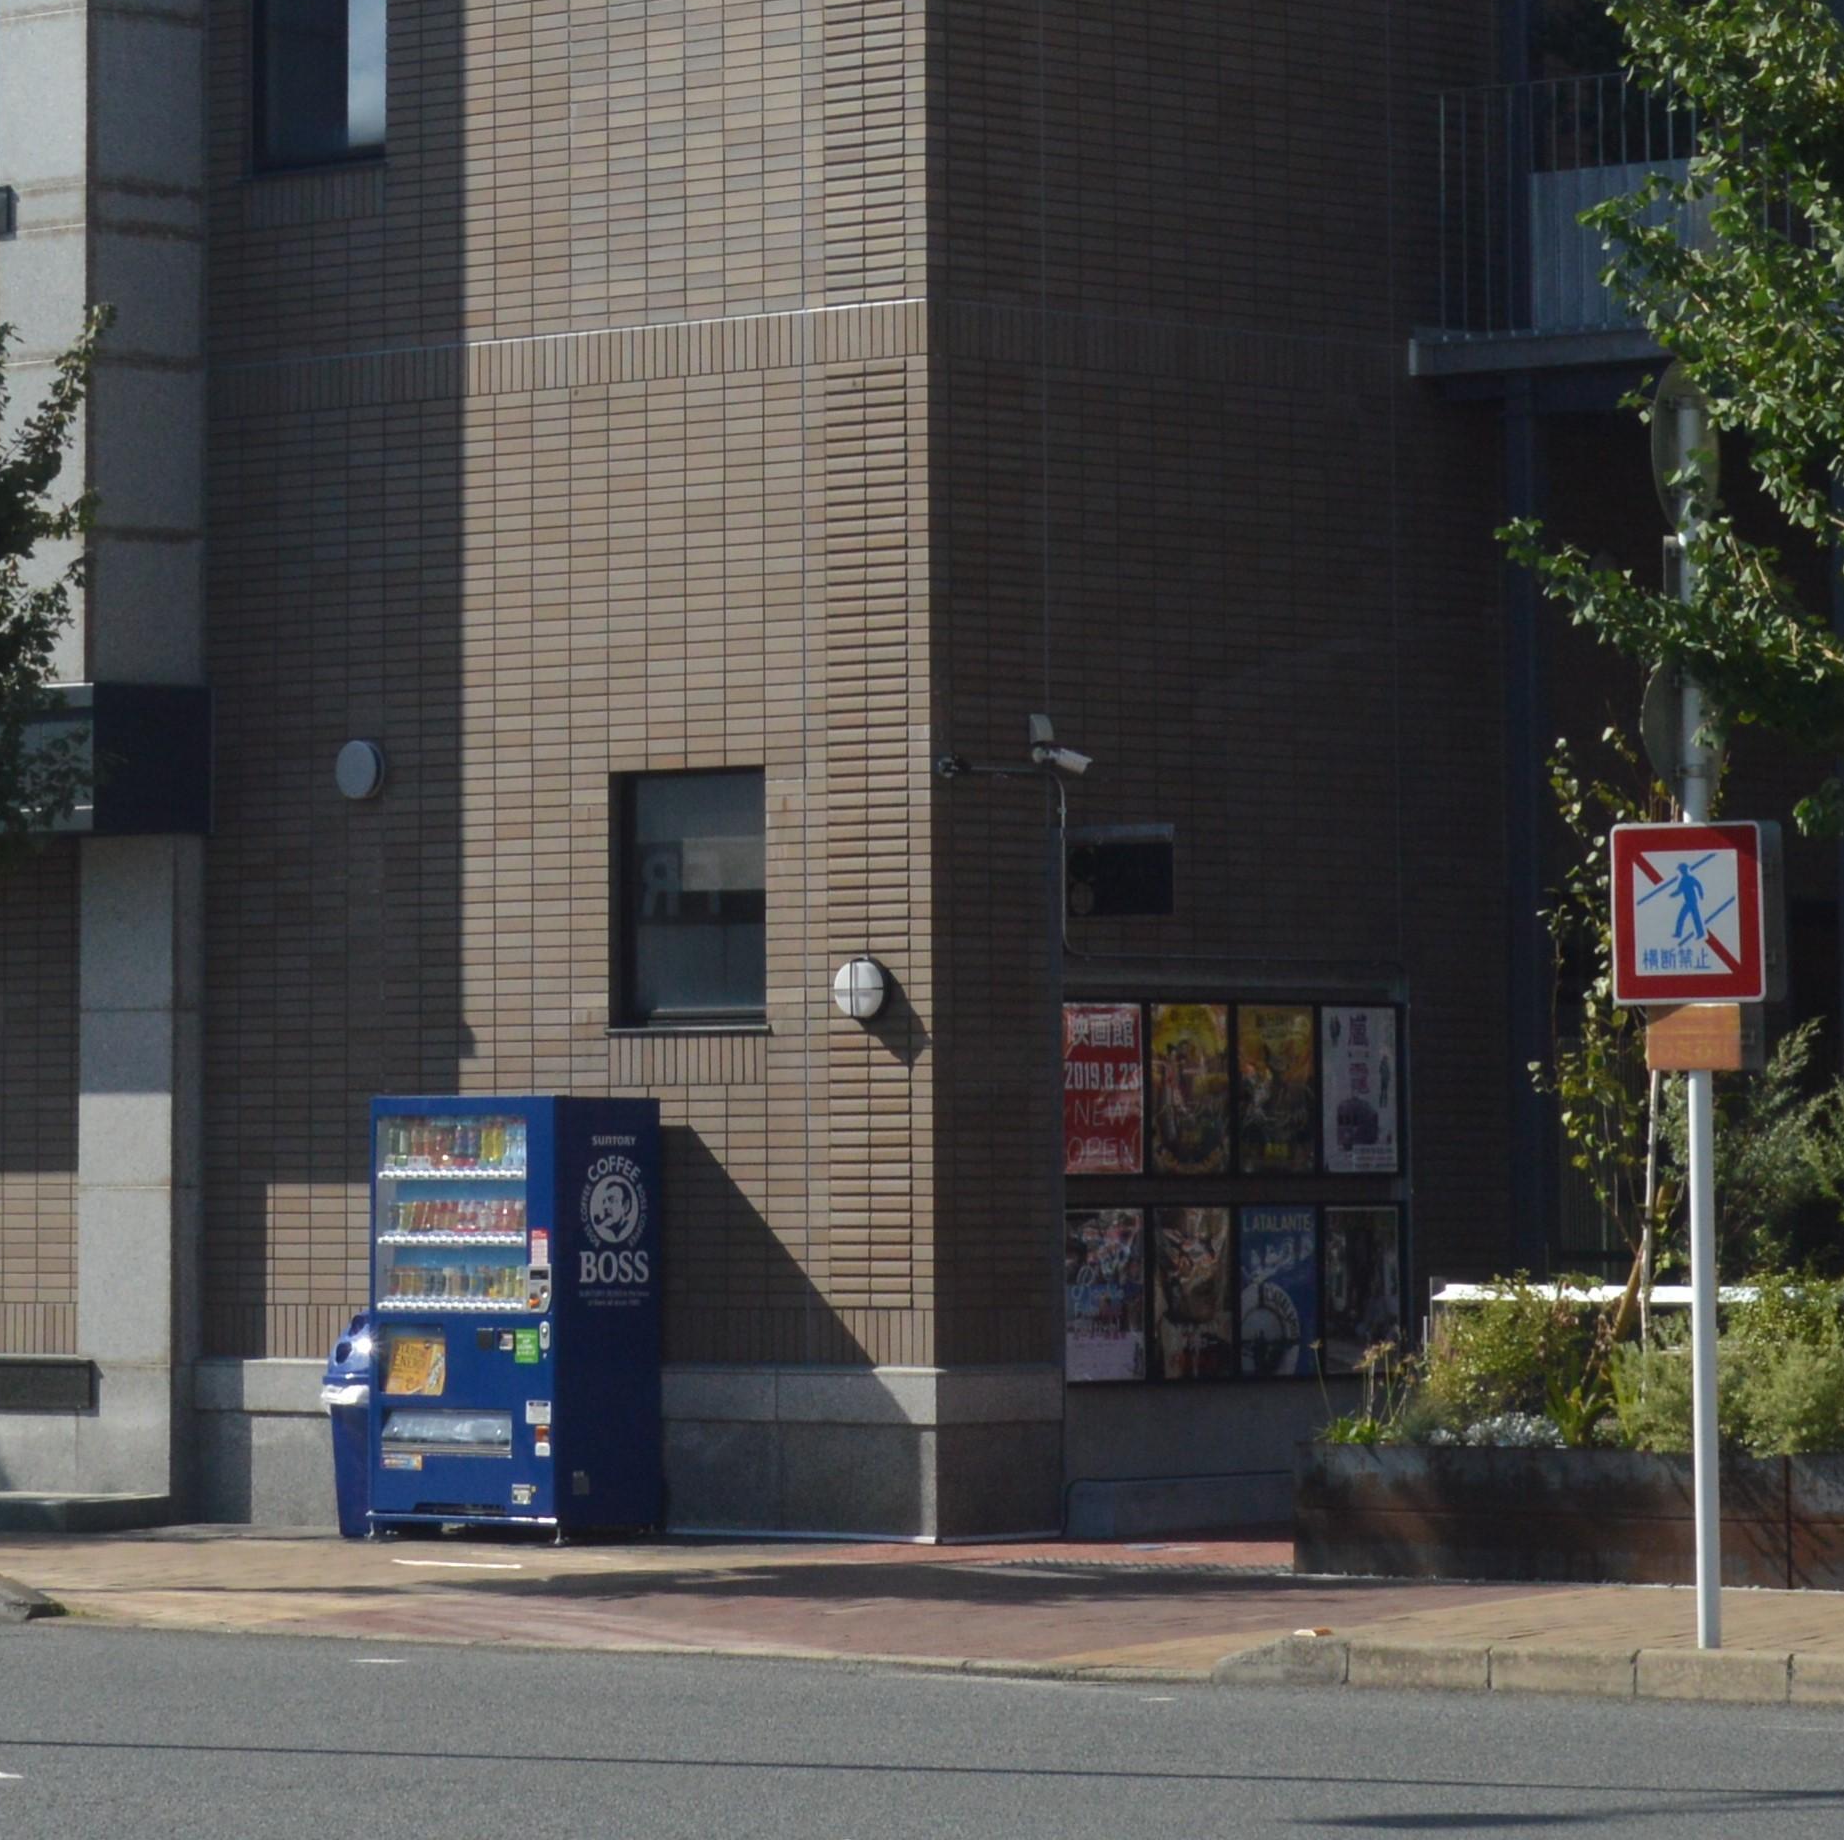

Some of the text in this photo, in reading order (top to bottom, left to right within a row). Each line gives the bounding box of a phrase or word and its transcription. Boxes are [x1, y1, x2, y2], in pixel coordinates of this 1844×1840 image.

[1643, 948, 1712, 971] 横断禁止
[1068, 1013, 1135, 1049] 映画館
[1073, 1098, 1131, 1127] NEW
[592, 1135, 637, 1147] SUNTORY
[1066, 1136, 1136, 1166] OPEN
[587, 1155, 641, 1183] COFFEE
[579, 1250, 650, 1284] BOSS
